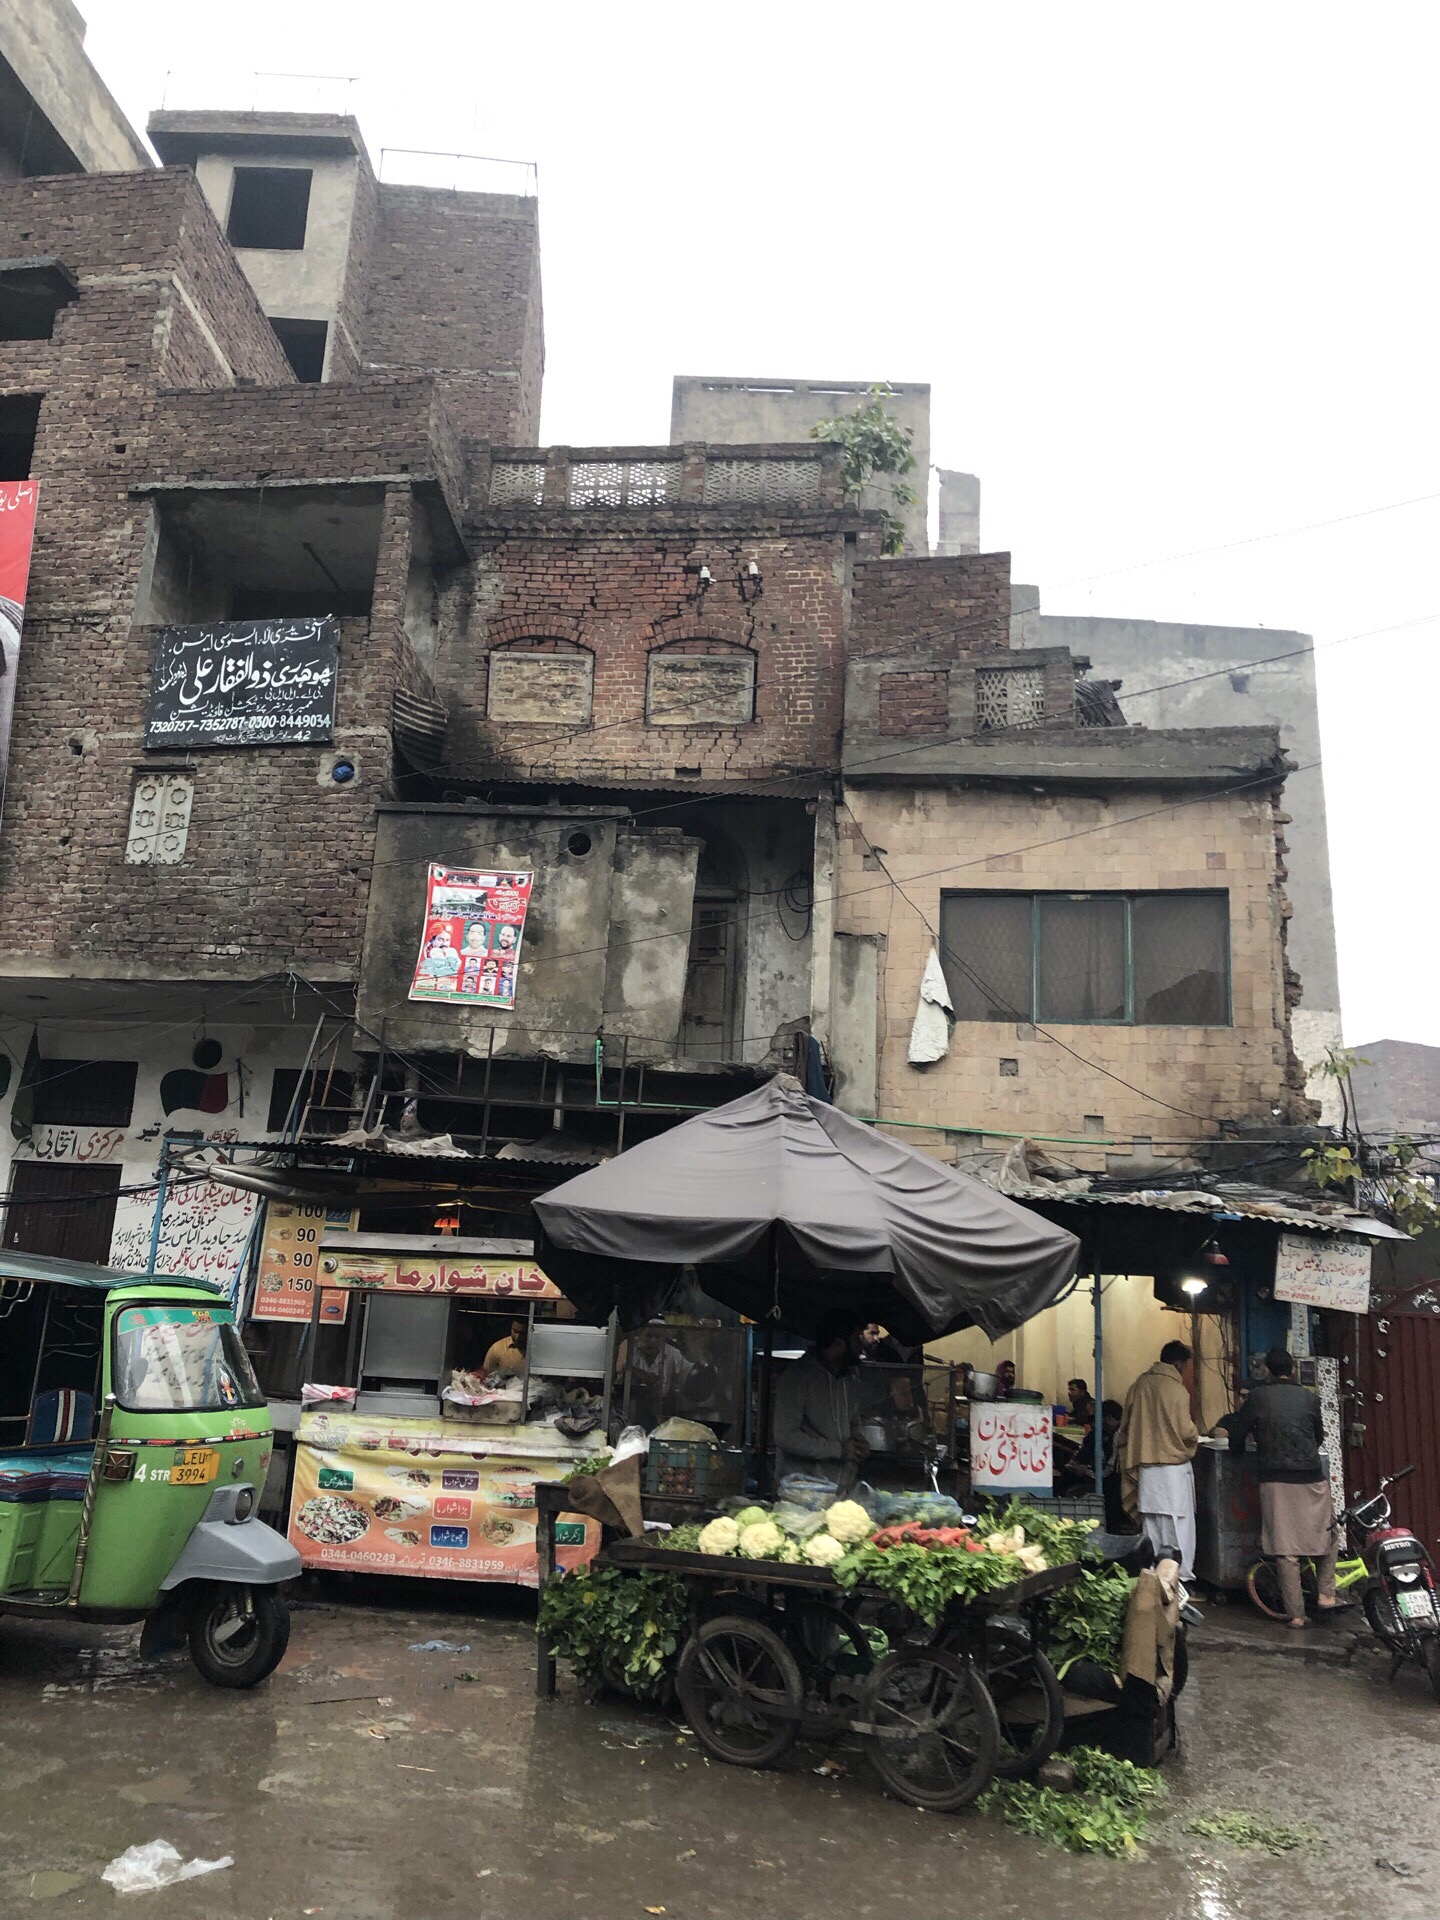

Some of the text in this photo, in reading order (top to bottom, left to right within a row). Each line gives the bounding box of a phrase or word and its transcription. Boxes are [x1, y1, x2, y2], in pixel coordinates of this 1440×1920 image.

[8, 481, 33, 511] اصلی
[179, 656, 214, 706] علی
[203, 651, 274, 696] ذوالفقار
[136, 1122, 162, 1142] تیر
[35, 1127, 77, 1159] انتخابی
[76, 1128, 125, 1161] مرکزی
[296, 1203, 324, 1219] 100
[297, 1227, 317, 1243] 90
[293, 1252, 313, 1267] 90
[287, 1277, 313, 1292] 150
[394, 1262, 548, 1296] خان شوارما
[182, 1452, 206, 1465] LEU
[988, 1439, 1018, 1476] فری
[134, 1463, 147, 1482] 4
[176, 1468, 206, 1482] 3994
[436, 1501, 458, 1514] شوارما
[432, 1530, 451, 1542] شوارما
[1384, 1540, 1411, 1551] METRO
[321, 1548, 396, 1563] 0344-0460249
